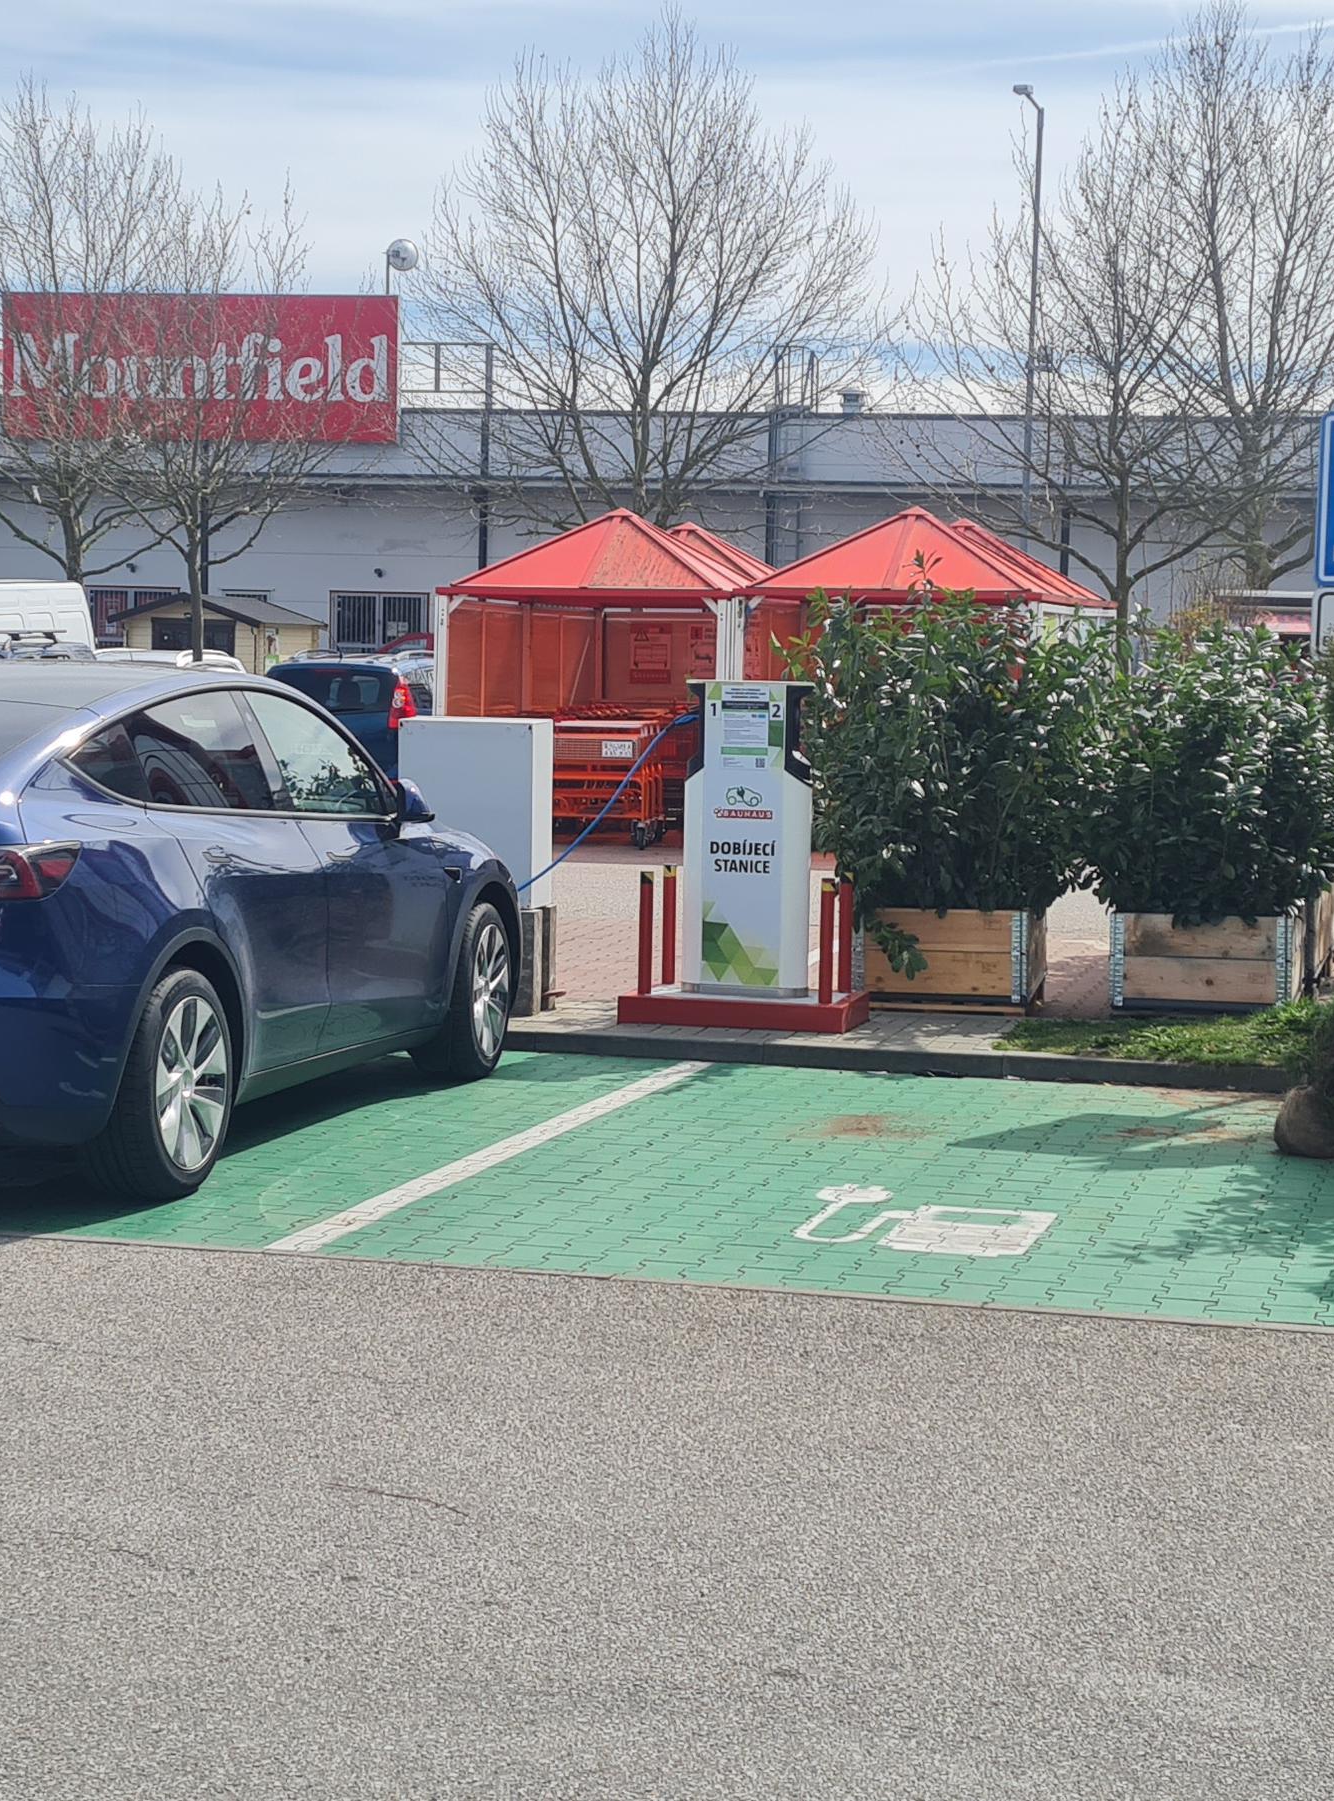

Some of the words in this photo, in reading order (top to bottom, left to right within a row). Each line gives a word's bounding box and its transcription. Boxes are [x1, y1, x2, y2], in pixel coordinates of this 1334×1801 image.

[7, 331, 389, 403] Mountfield
[710, 703, 717, 717] 1
[771, 703, 782, 718] 2
[725, 810, 772, 819] BAUHAUS
[709, 839, 777, 857] DOBÍJECÍ
[714, 858, 771, 874] STANICE
